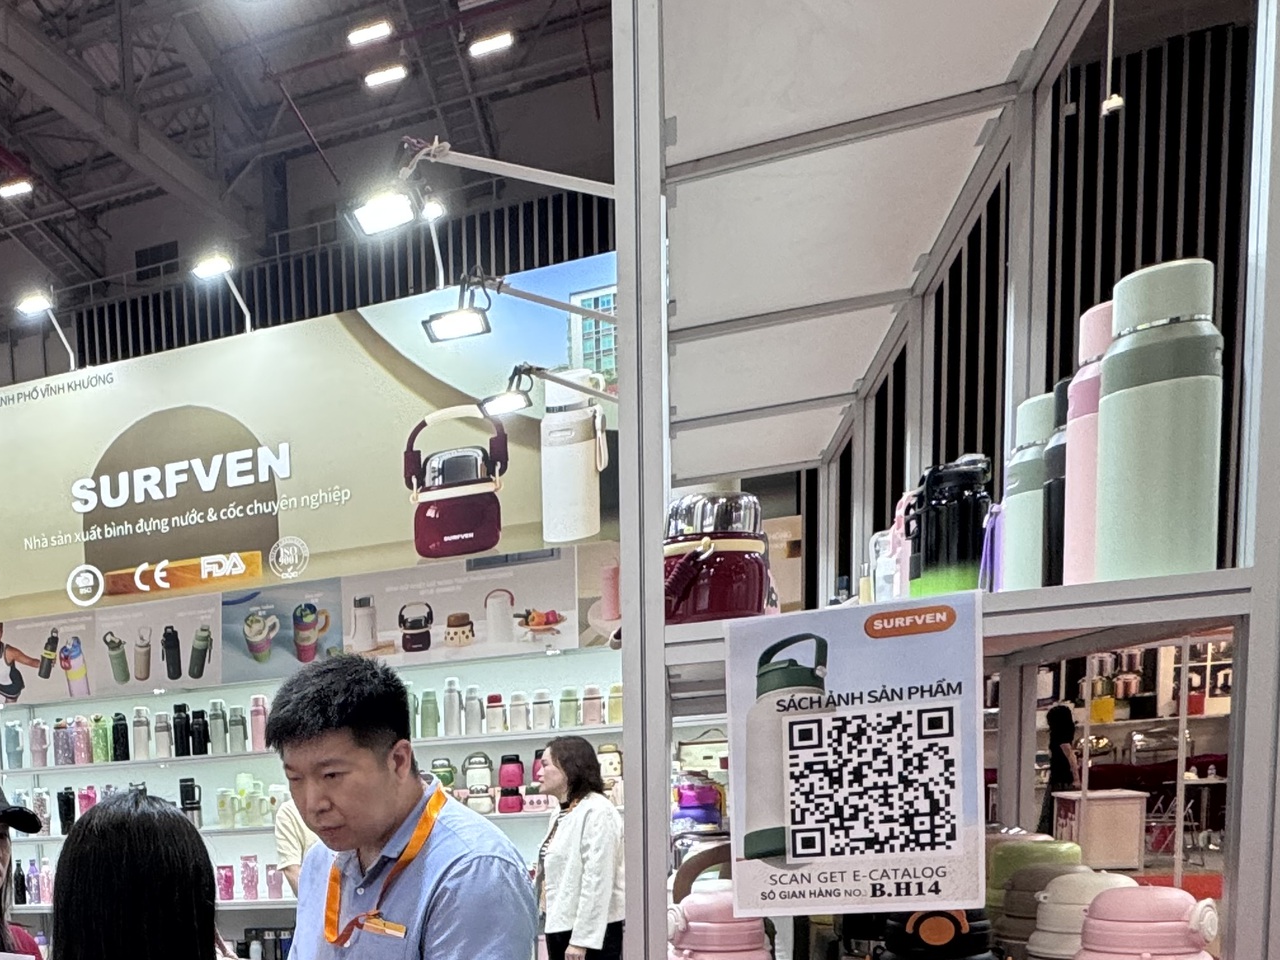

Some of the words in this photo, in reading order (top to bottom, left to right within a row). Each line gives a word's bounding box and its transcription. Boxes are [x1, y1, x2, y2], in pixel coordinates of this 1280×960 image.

[16, 386, 39, 403] PHỐ
[71, 441, 292, 515] SURFVEN
[23, 535, 48, 550] Nhà
[50, 529, 72, 547] sản
[73, 522, 103, 544] xuất
[104, 517, 133, 539] bình
[135, 515, 170, 538] đựng
[171, 505, 205, 526] nước
[206, 507, 218, 522] &
[220, 500, 244, 519] cốc
[246, 491, 298, 518] chuyên
[300, 486, 351, 512] nghiệp
[133, 559, 170, 592] CE
[200, 552, 246, 580] FDA
[873, 611, 947, 630] SURFVEN
[776, 694, 822, 713] SÁCH
[824, 688, 864, 709] ẢNH
[867, 684, 904, 704] SẢN
[907, 677, 963, 700] PHẨM
[769, 872, 812, 886] SCAN
[817, 870, 847, 883] GET
[853, 866, 947, 882] E-CATALOG
[778, 889, 806, 899] GIAN
[809, 886, 841, 898] HÀNG
[870, 880, 942, 898] B.H14
